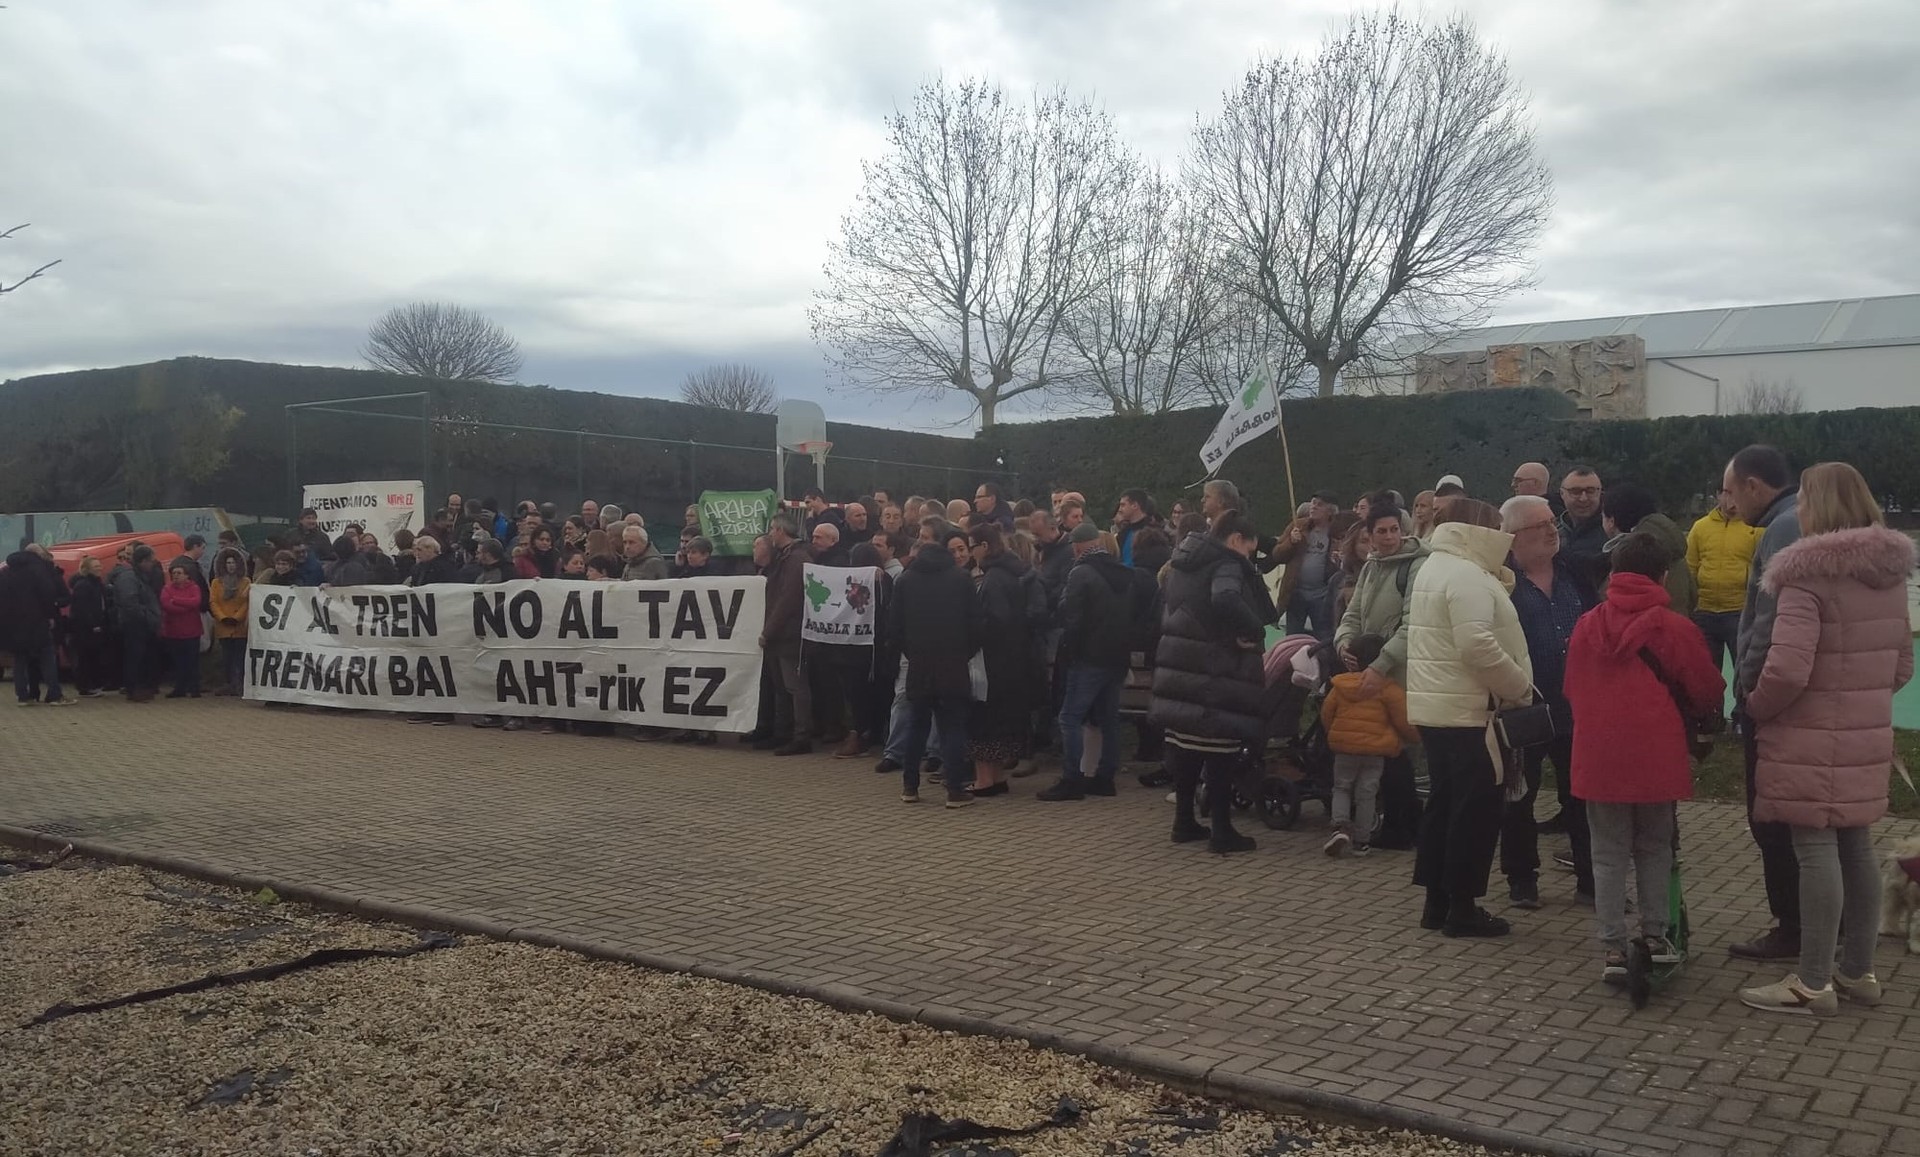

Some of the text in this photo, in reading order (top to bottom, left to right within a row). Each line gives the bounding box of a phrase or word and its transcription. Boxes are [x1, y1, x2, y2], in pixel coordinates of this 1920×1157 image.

[310, 495, 377, 510] DEFENDAMOS
[258, 589, 746, 640] SI AL TREN NO AL TAV
[854, 623, 873, 636] EZ
[249, 647, 728, 718] TRENARI BAI AHT-rik EZ
